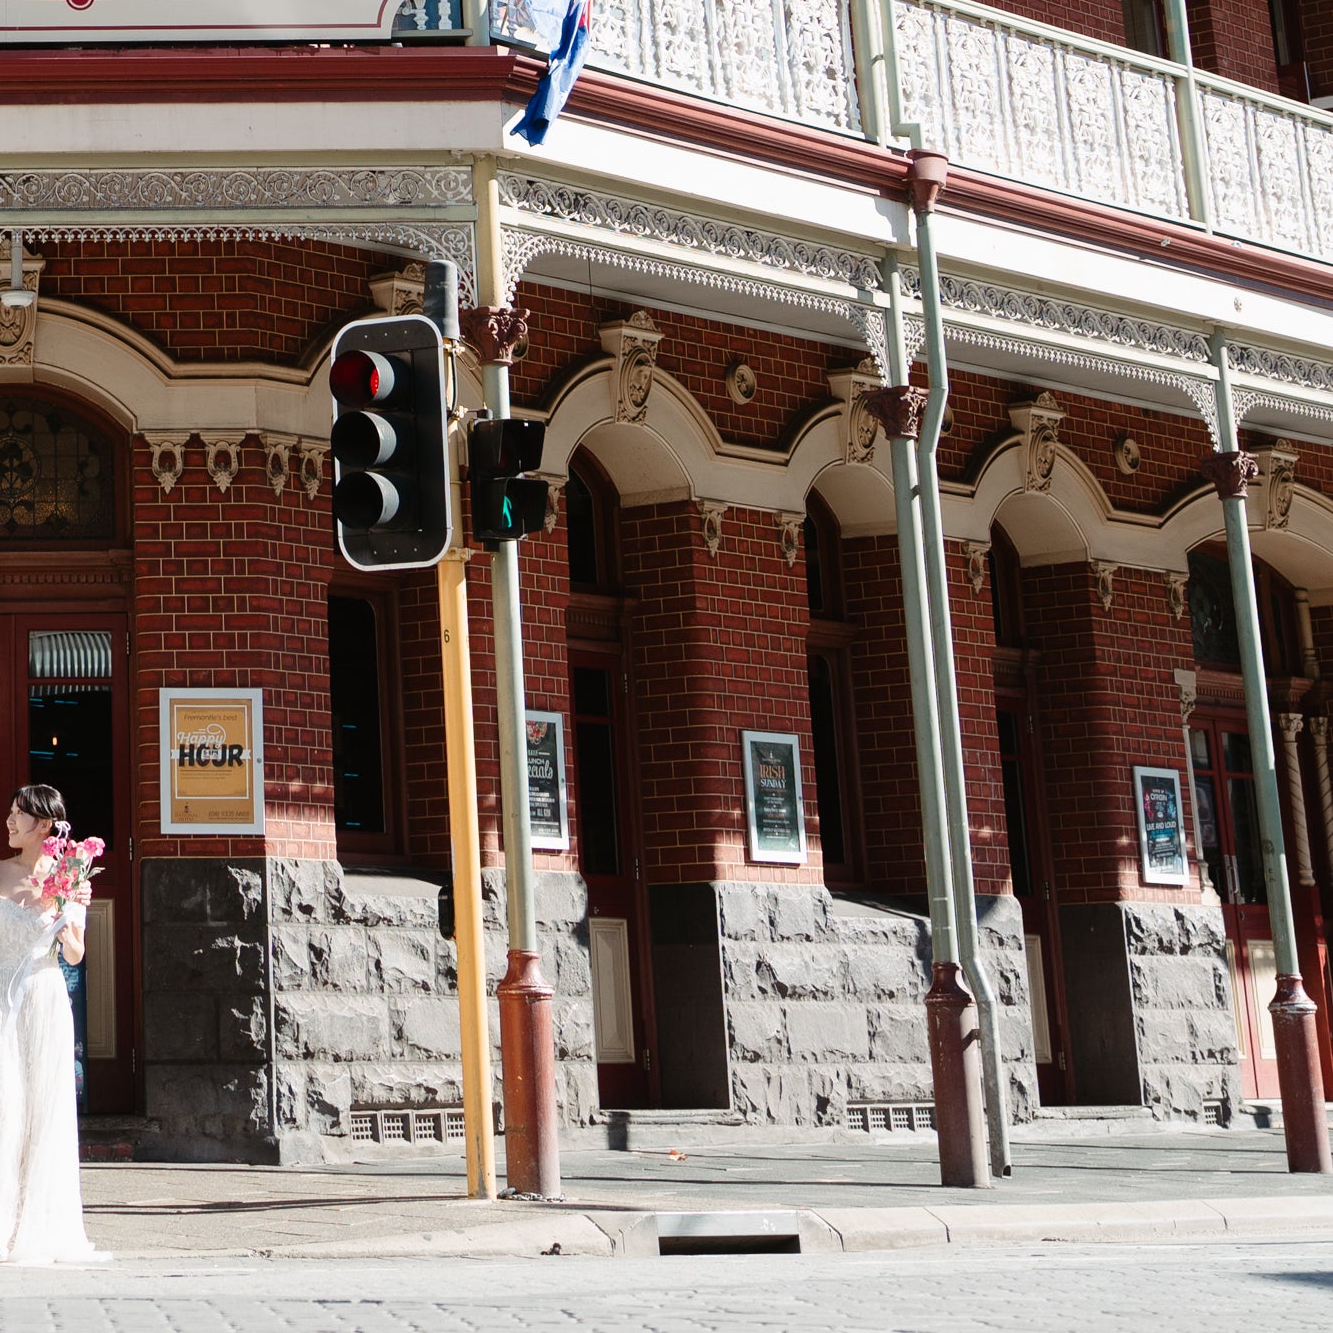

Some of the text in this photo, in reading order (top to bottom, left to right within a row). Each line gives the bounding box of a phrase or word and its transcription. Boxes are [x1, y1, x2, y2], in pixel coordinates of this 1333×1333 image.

[443, 629, 450, 644] 6
[179, 744, 243, 767] HOUR
[759, 765, 785, 779] IRISH
[760, 779, 786, 789] SUNDAY
[1165, 821, 1176, 829] LOUD
